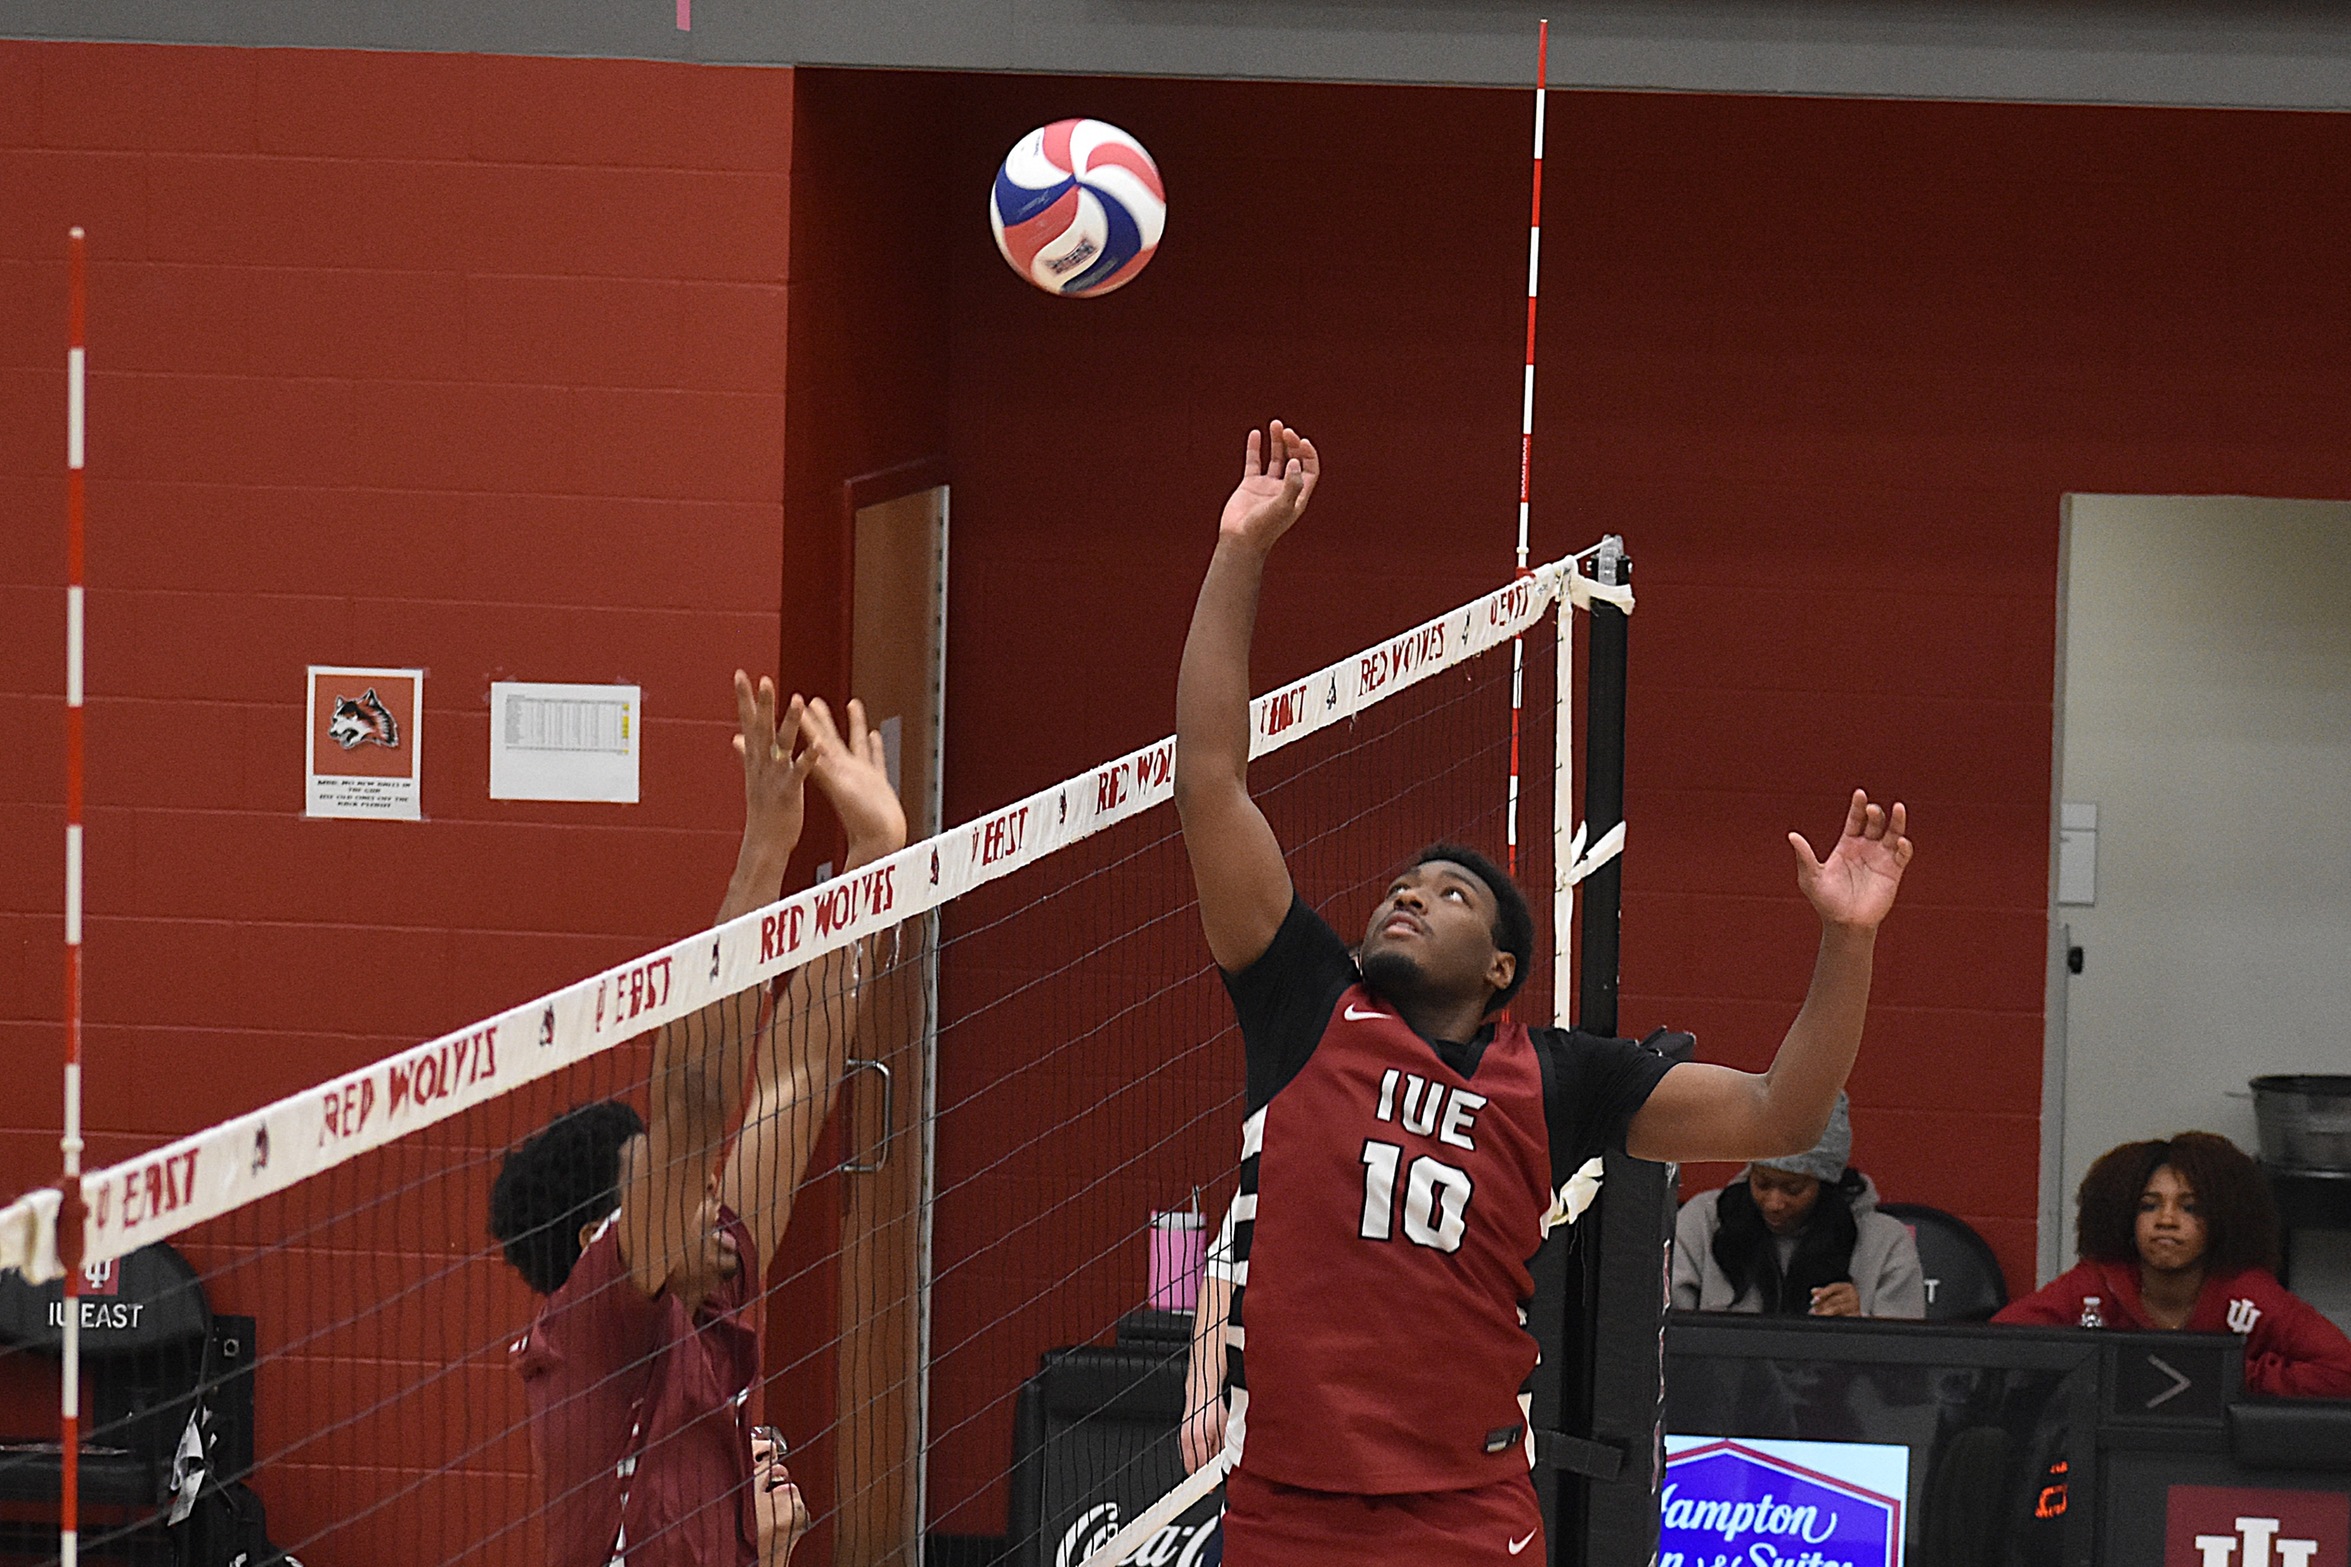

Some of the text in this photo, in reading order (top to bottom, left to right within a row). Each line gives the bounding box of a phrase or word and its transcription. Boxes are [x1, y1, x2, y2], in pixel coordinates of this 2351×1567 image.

[1358, 650, 1388, 697] RED
[1095, 742, 1173, 816] RED WOL
[760, 864, 896, 964] RED WOLVES
[616, 956, 672, 1024] EAST
[319, 1077, 374, 1147] RED
[1376, 1068, 1488, 1151] IUE
[123, 1148, 199, 1231] EAST
[1361, 1139, 1473, 1253] 10
[81, 1303, 144, 1328] EAST
